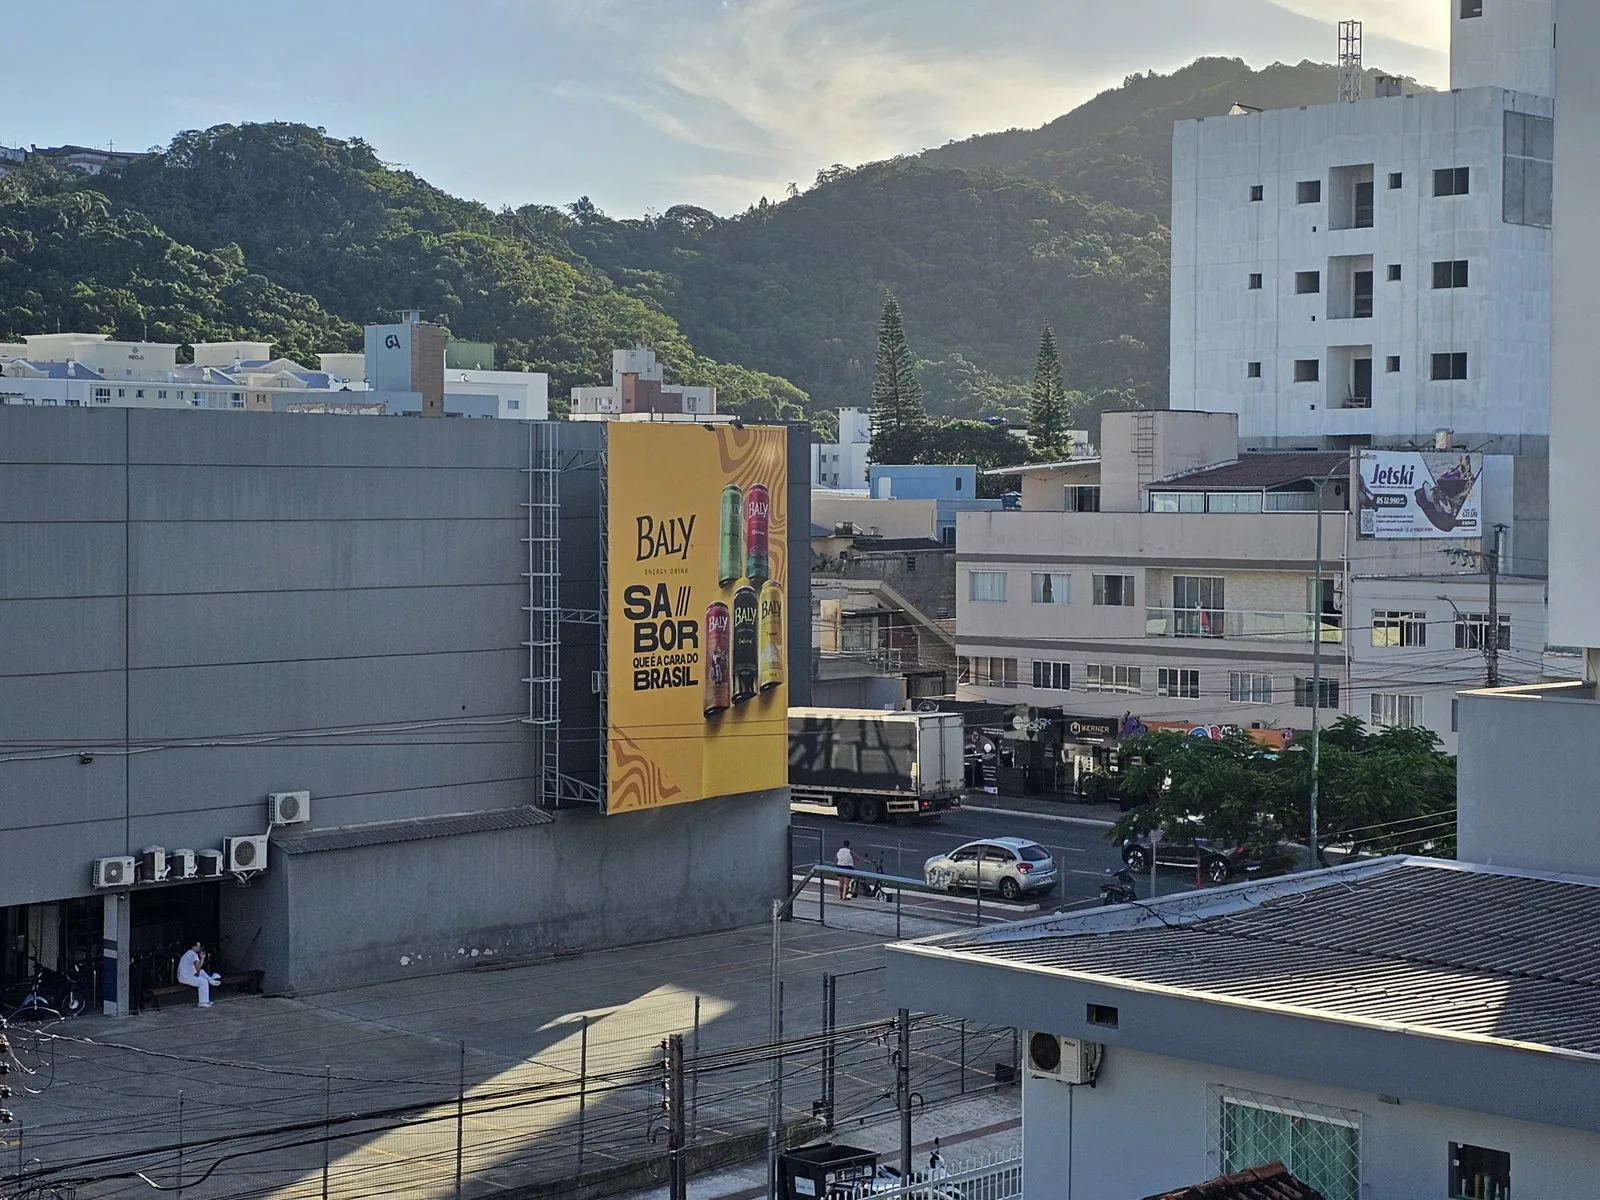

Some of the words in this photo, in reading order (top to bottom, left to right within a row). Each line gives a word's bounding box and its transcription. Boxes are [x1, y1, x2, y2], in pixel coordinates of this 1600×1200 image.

[1370, 464, 1415, 485] Jetski
[749, 501, 769, 519] BALY
[636, 514, 696, 562] BALY
[644, 568, 668, 576] ENERGY
[734, 606, 757, 628] BALY
[761, 600, 782, 620] BALY
[708, 615, 728, 633] BALY
[633, 619, 699, 654] BOR
[633, 657, 650, 669] QUE
[650, 653, 656, 667] É
[656, 655, 663, 666] A
[663, 653, 686, 666] CARA
[687, 652, 699, 664] DO
[633, 666, 699, 691] BRASIL
[1081, 724, 1110, 734] WERNER
